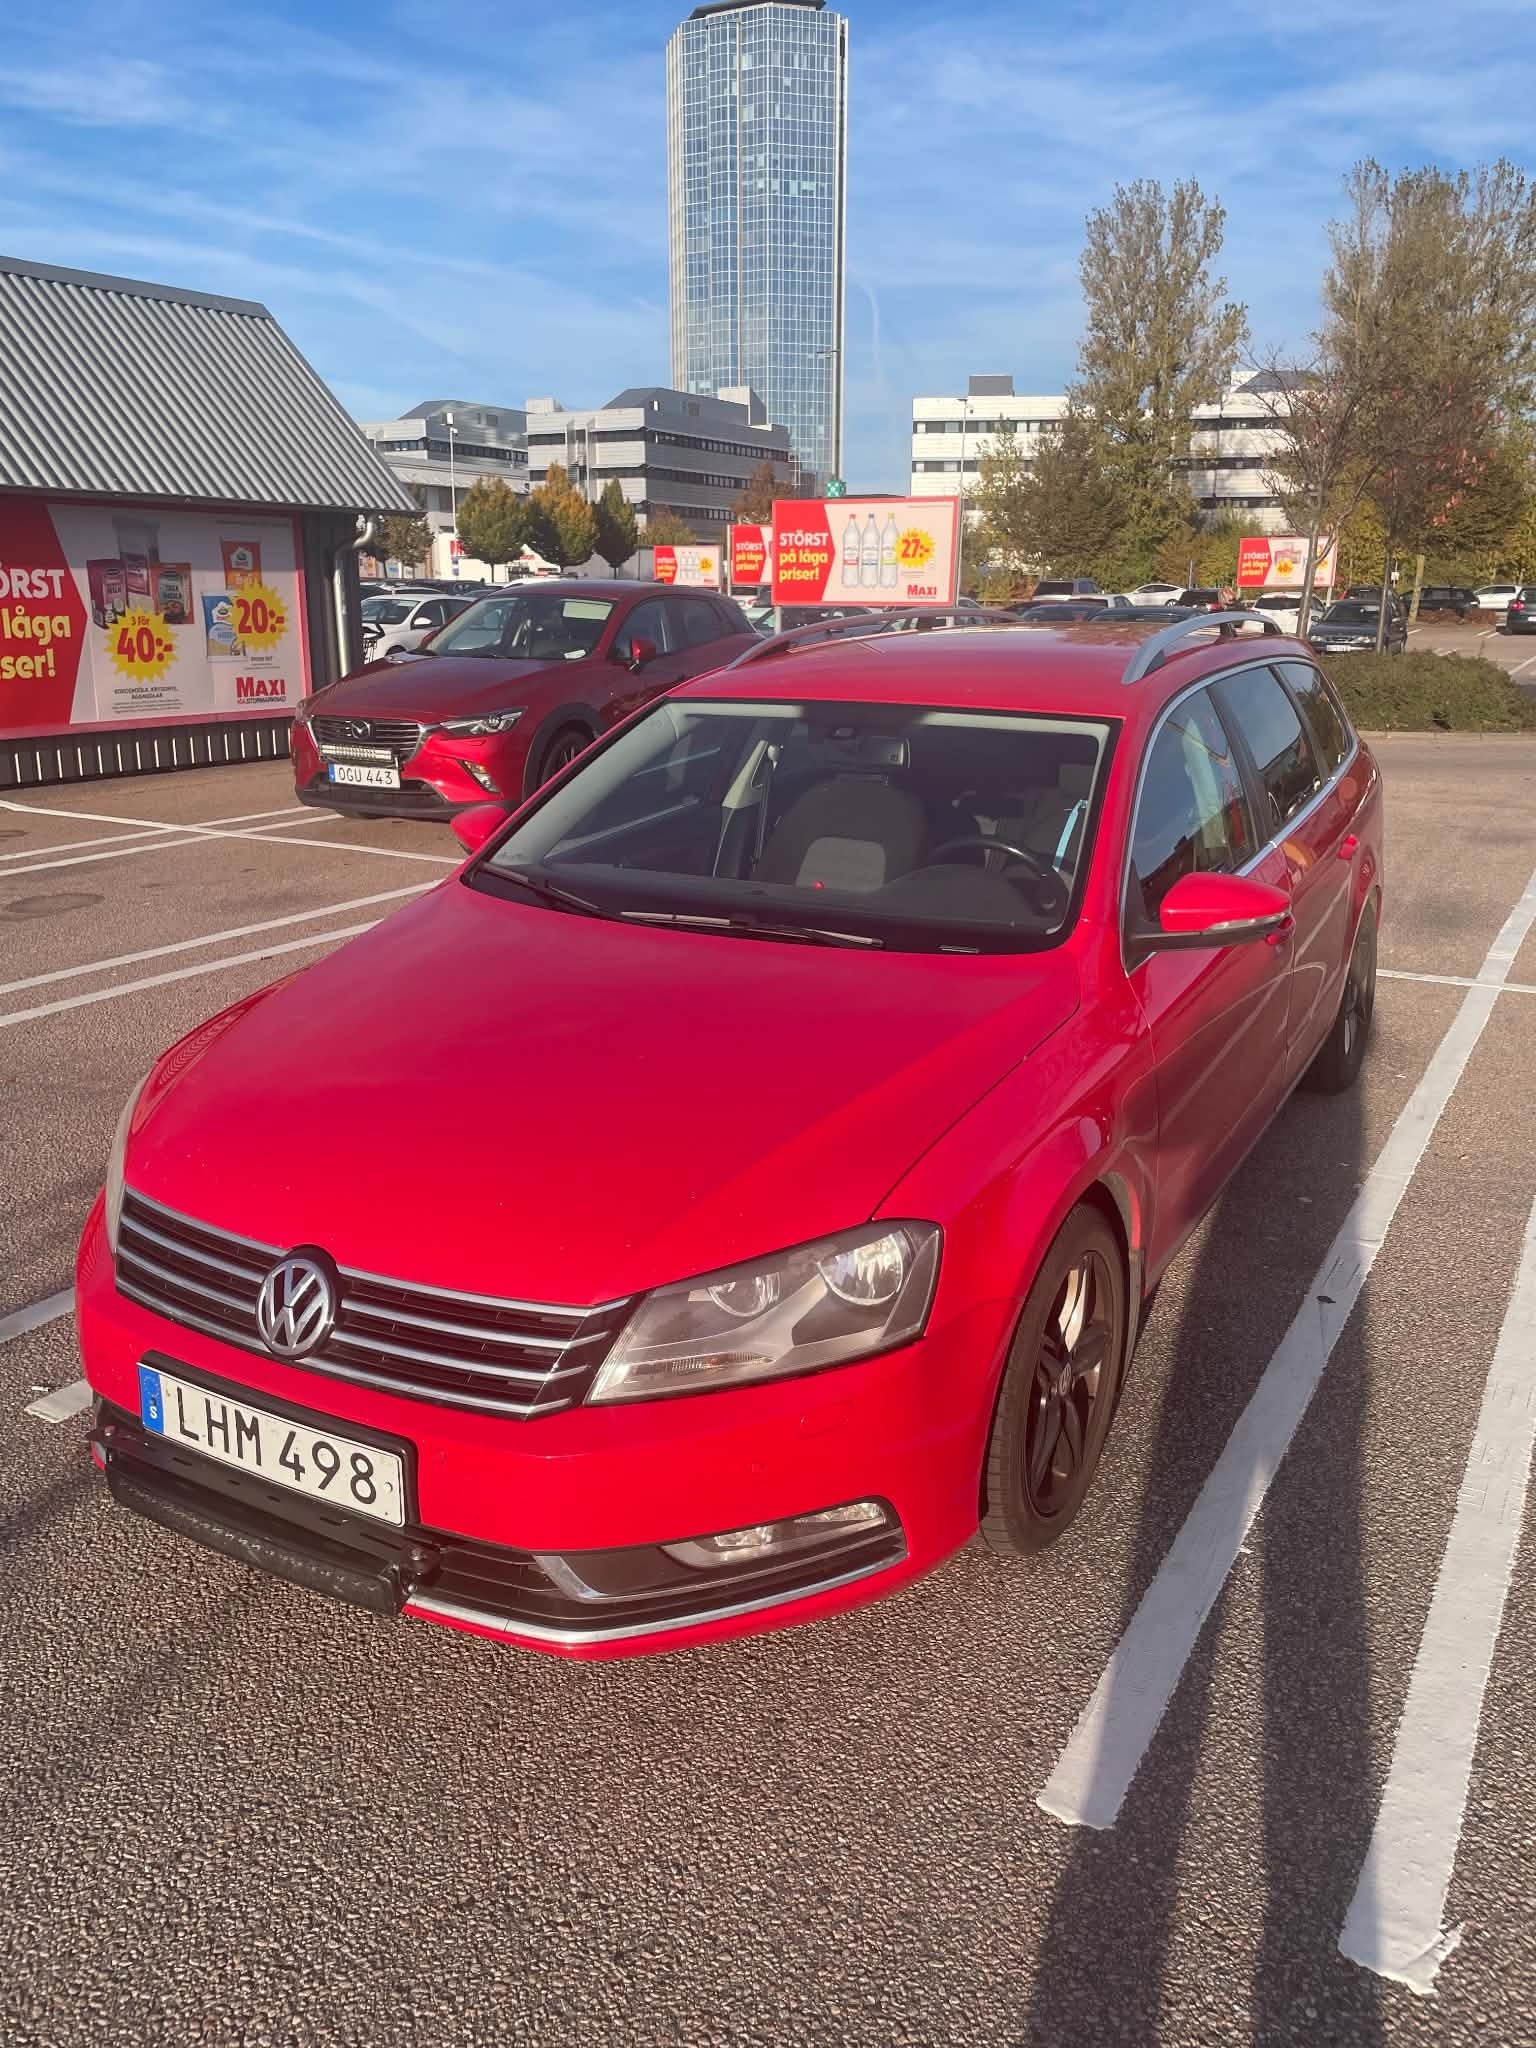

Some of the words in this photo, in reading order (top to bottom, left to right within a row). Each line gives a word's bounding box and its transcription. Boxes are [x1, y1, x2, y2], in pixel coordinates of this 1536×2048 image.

[779, 529, 829, 547] STÖRST
[779, 548, 797, 566] på
[799, 548, 829, 566] låga
[901, 538, 930, 558] 27:-
[779, 567, 819, 583] priser!
[131, 616, 136, 626] 3
[236, 598, 285, 634] 20:-
[2, 605, 72, 646] låga
[117, 626, 173, 663] 40:-
[338, 767, 362, 783] OGU
[366, 769, 393, 785] 443
[150, 1405, 158, 1419] S
[176, 1386, 262, 1467] LHM
[278, 1430, 377, 1505] 498
